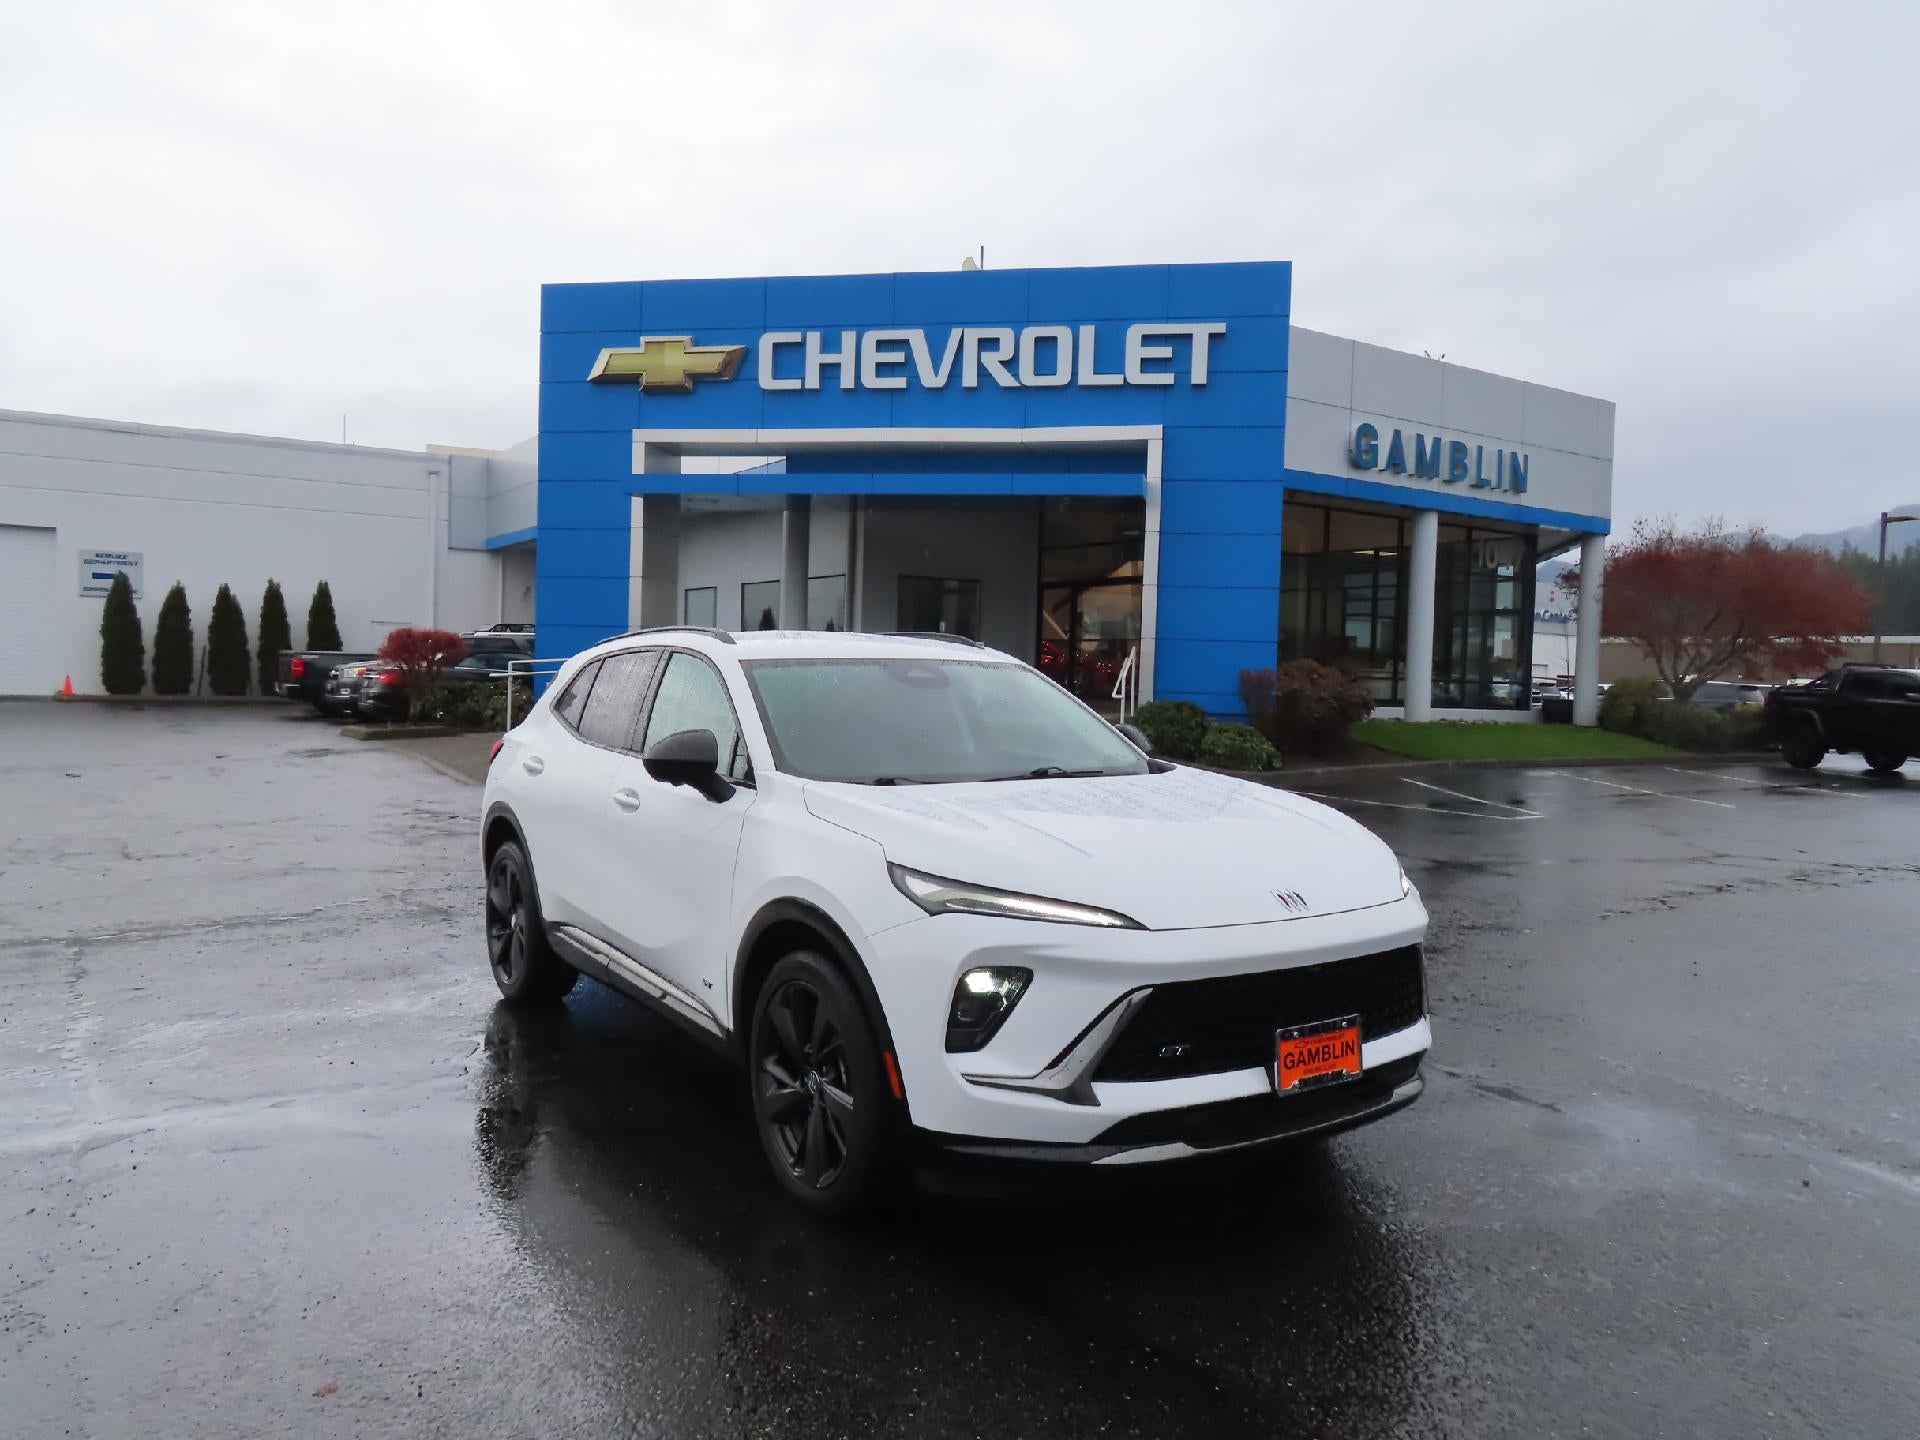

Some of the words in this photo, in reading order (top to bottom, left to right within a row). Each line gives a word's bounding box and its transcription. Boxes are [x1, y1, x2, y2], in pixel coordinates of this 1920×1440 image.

[758, 322, 1227, 390] CHEVROLET
[1351, 422, 1529, 494] GAMBLIN
[1283, 1039, 1355, 1071] GAMBLIN
